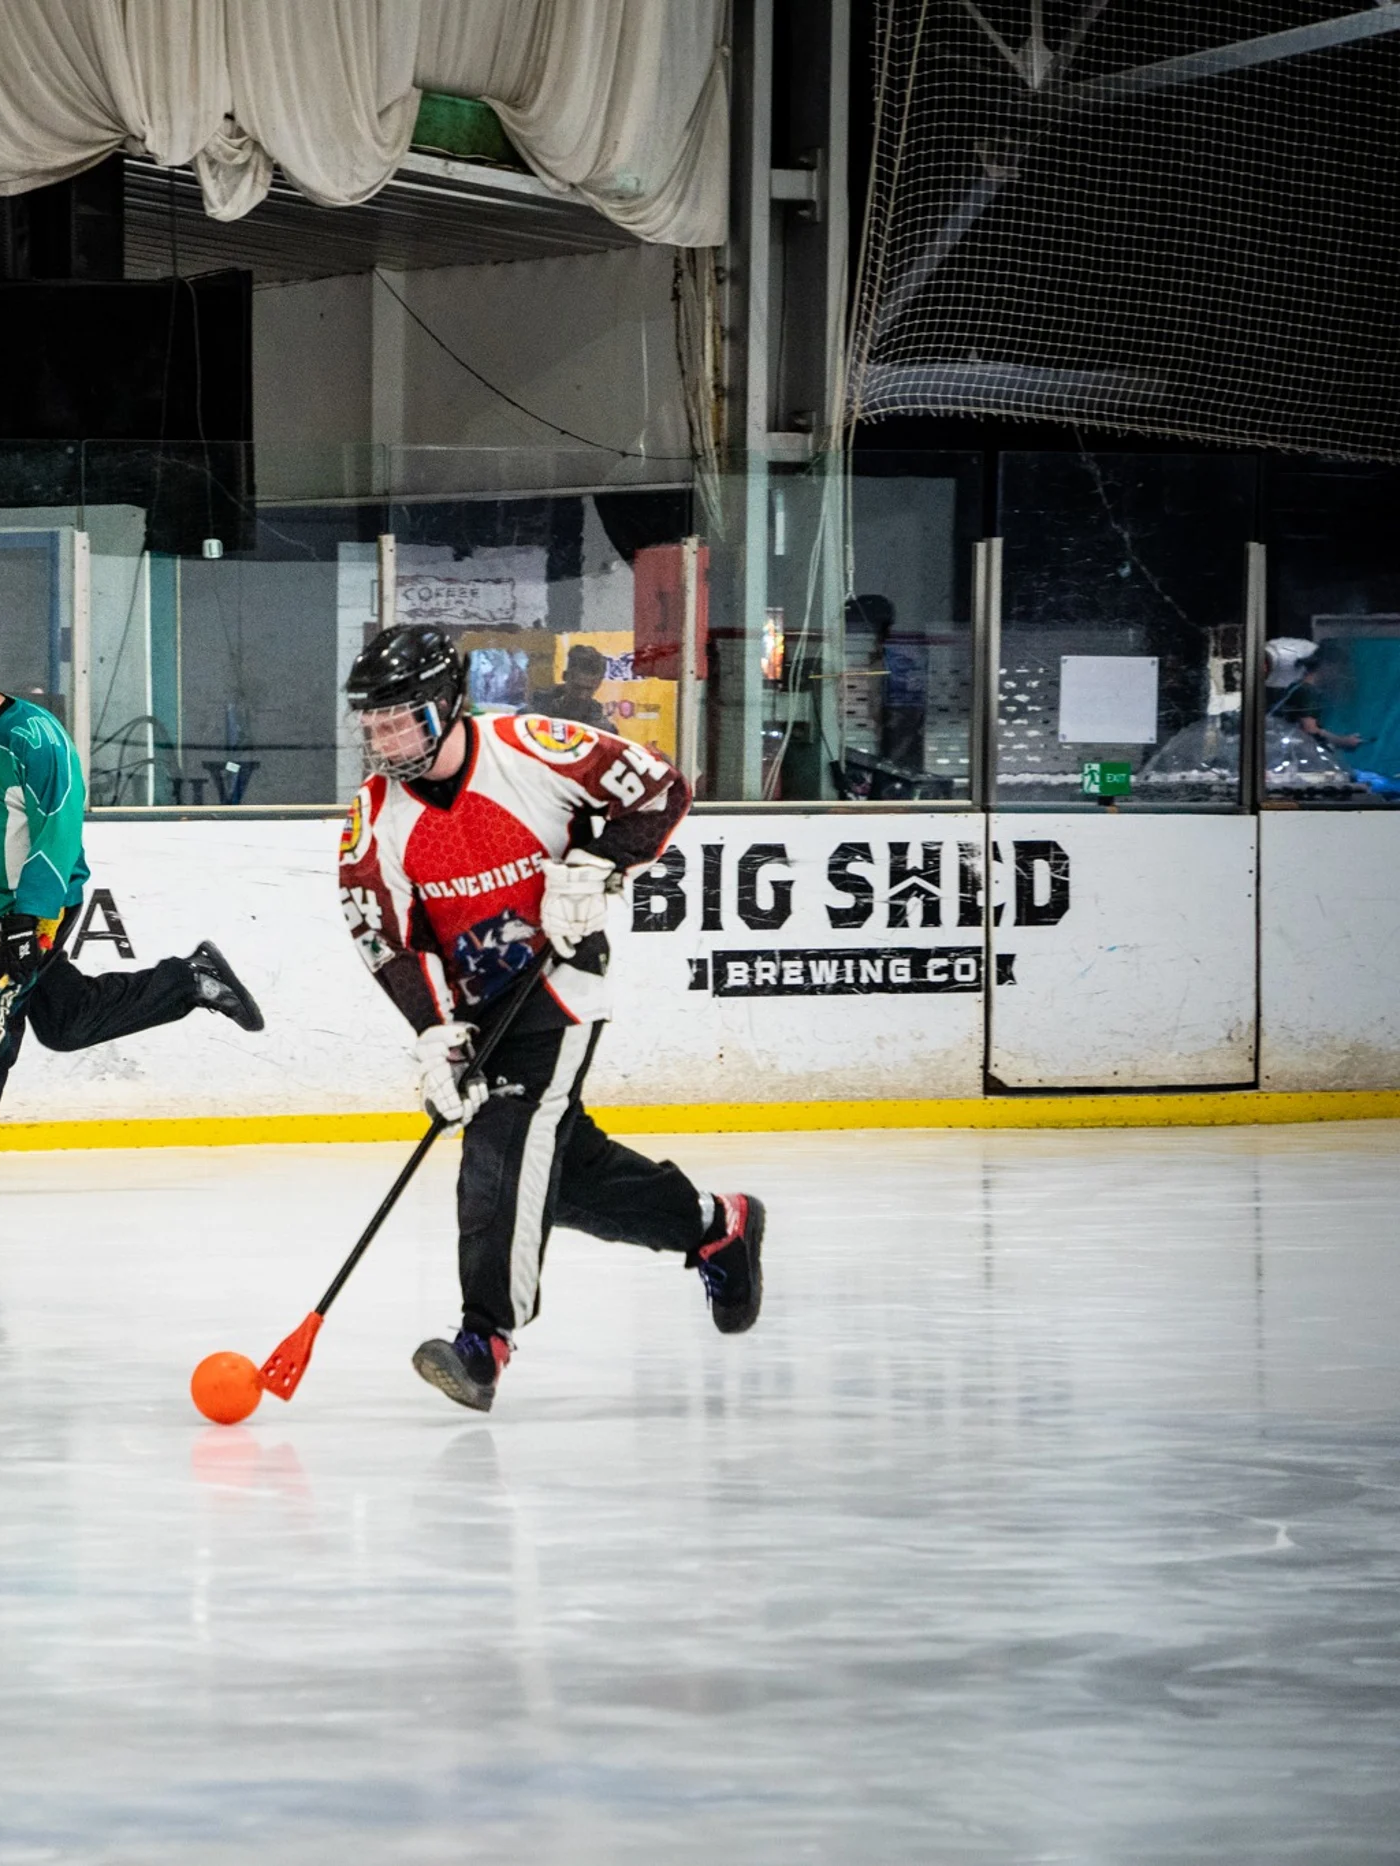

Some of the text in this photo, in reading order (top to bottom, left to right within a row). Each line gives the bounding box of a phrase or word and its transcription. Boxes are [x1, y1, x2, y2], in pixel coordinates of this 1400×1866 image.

[600, 745, 669, 808] 64
[631, 840, 1070, 932] BIG SHED
[726, 957, 977, 986] BREWING CO
